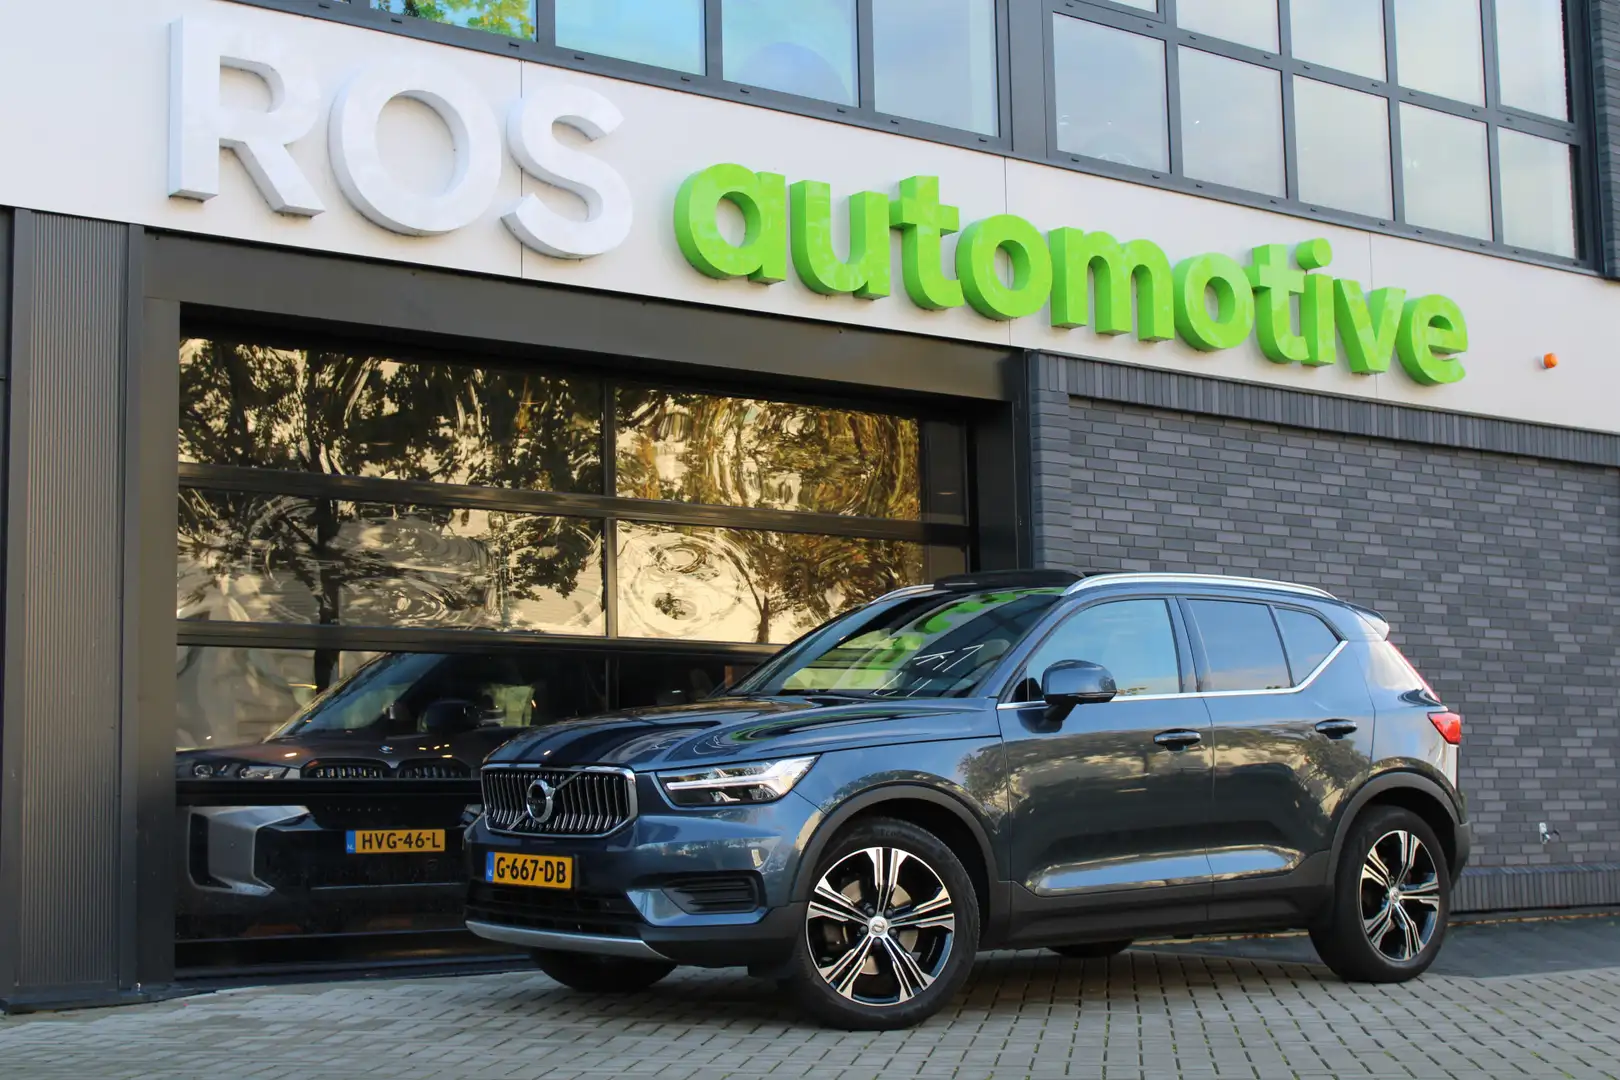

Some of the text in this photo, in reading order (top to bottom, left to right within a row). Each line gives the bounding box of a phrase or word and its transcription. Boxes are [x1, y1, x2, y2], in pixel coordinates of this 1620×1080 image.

[168, 15, 1468, 385] ROS automotive
[362, 831, 441, 851] HVG-46-L
[496, 856, 567, 884] G-667-DB
